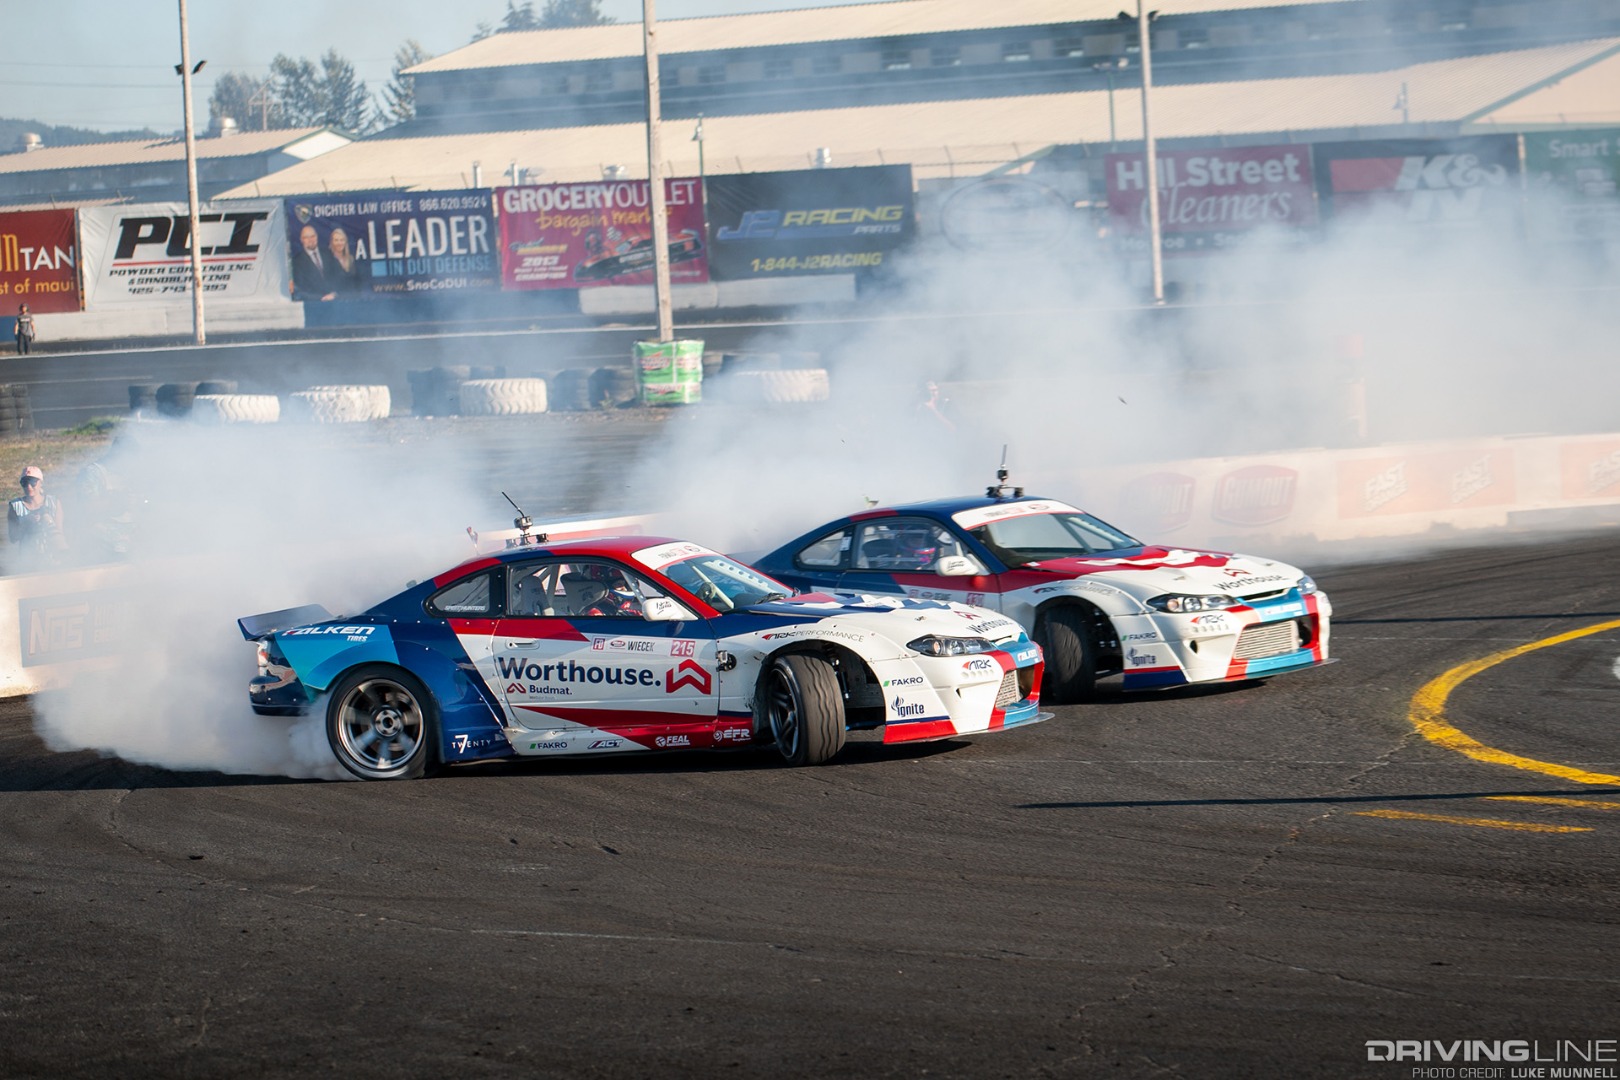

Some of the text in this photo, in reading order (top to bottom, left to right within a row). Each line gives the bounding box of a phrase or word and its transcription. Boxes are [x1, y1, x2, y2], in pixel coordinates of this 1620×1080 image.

[1549, 137, 1610, 158] Smart
[1116, 153, 1301, 191] Hll Street
[314, 203, 356, 218] DICHTER
[357, 201, 378, 215] LAW
[380, 199, 412, 214] OFFICE
[535, 207, 608, 236] bargain
[717, 206, 904, 240] J2 RACING
[852, 225, 901, 235] PARTS
[114, 212, 268, 260] PCI
[355, 238, 367, 261] A
[367, 215, 490, 260] LEADER
[389, 256, 492, 277] IN DUI DEFENSE
[751, 253, 882, 272] 1-844-J2RACING
[109, 267, 165, 277] POWDER
[14, 278, 31, 294] of
[35, 279, 74, 292] maui
[28, 602, 90, 654] NOS
[282, 627, 375, 636] FALKEN
[795, 631, 864, 642] PERFORMANCE
[1129, 632, 1157, 640] FAKRO
[671, 640, 695, 657] 215
[498, 657, 661, 686] Worthouse.
[529, 685, 572, 695] Budmat.
[891, 677, 924, 686] FAKRO
[898, 704, 925, 717] ignite
[667, 735, 690, 743] FEAL
